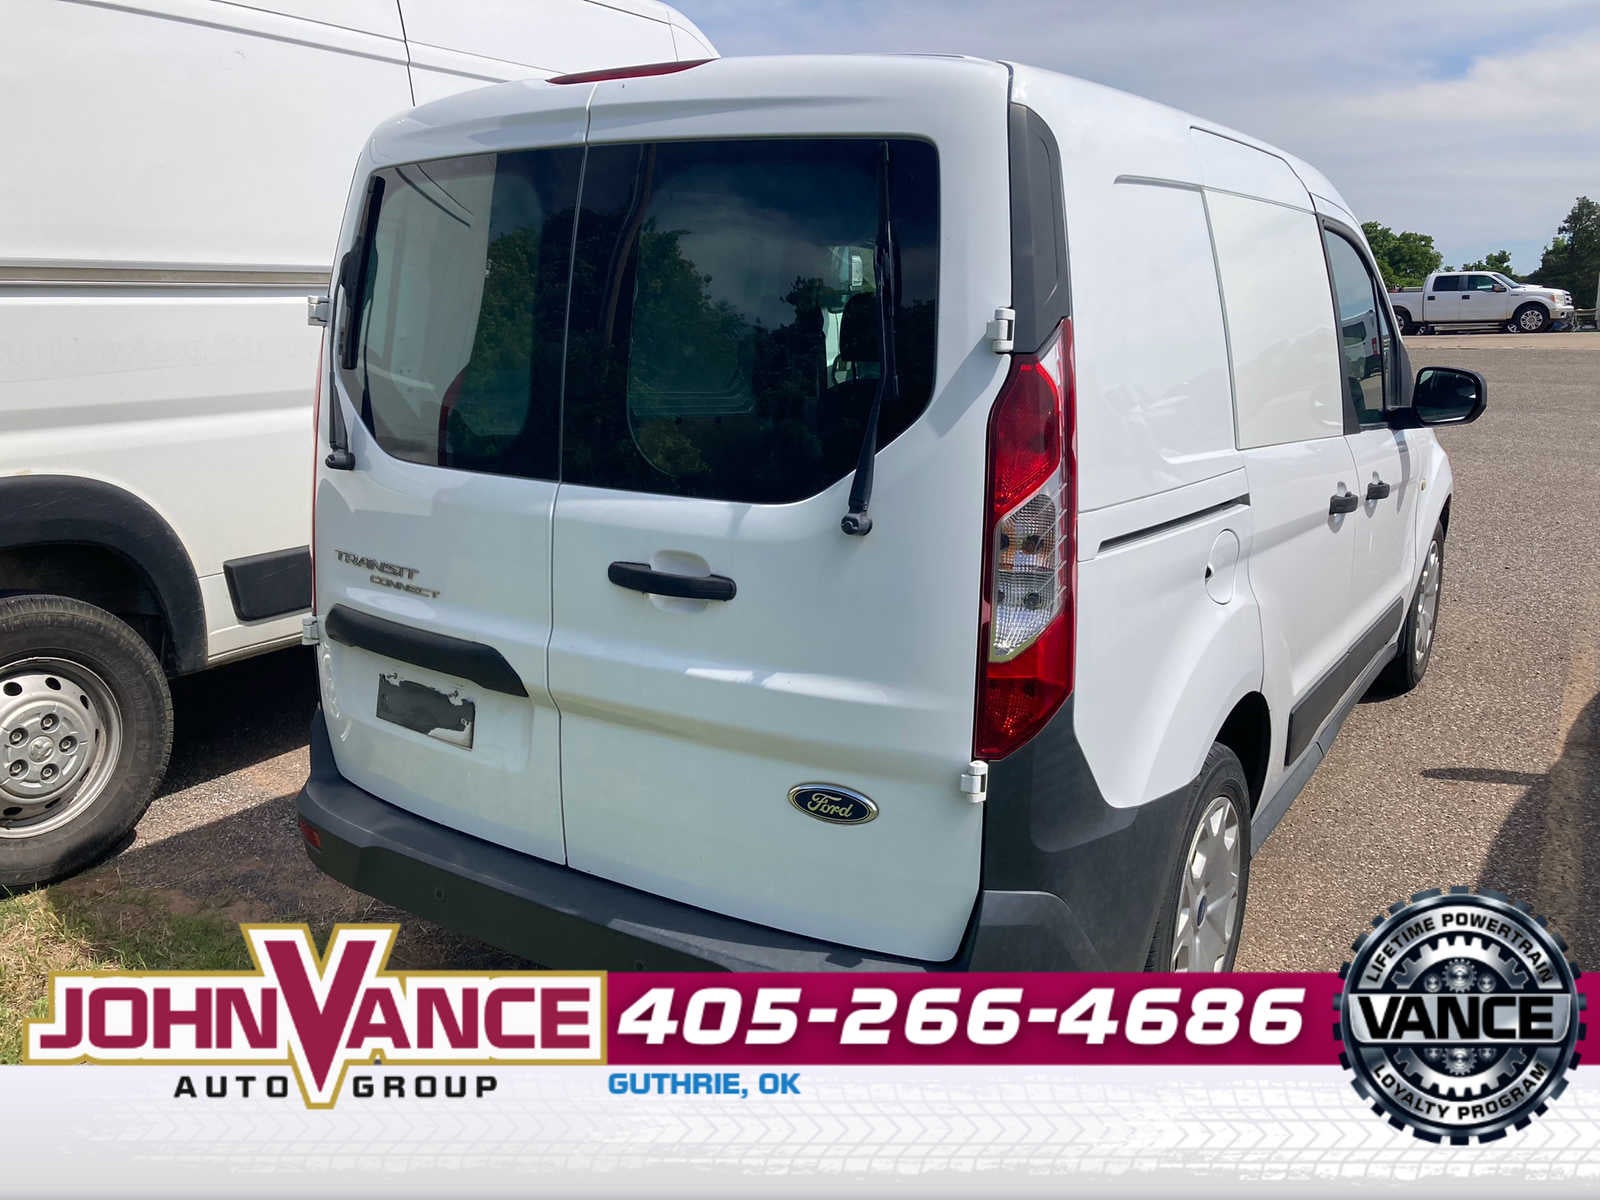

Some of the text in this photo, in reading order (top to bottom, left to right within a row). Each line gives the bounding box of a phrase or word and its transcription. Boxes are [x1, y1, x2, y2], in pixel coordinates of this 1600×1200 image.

[334, 548, 420, 580] TRANSIT
[369, 574, 441, 598] CONNECT
[807, 792, 854, 818] Ford
